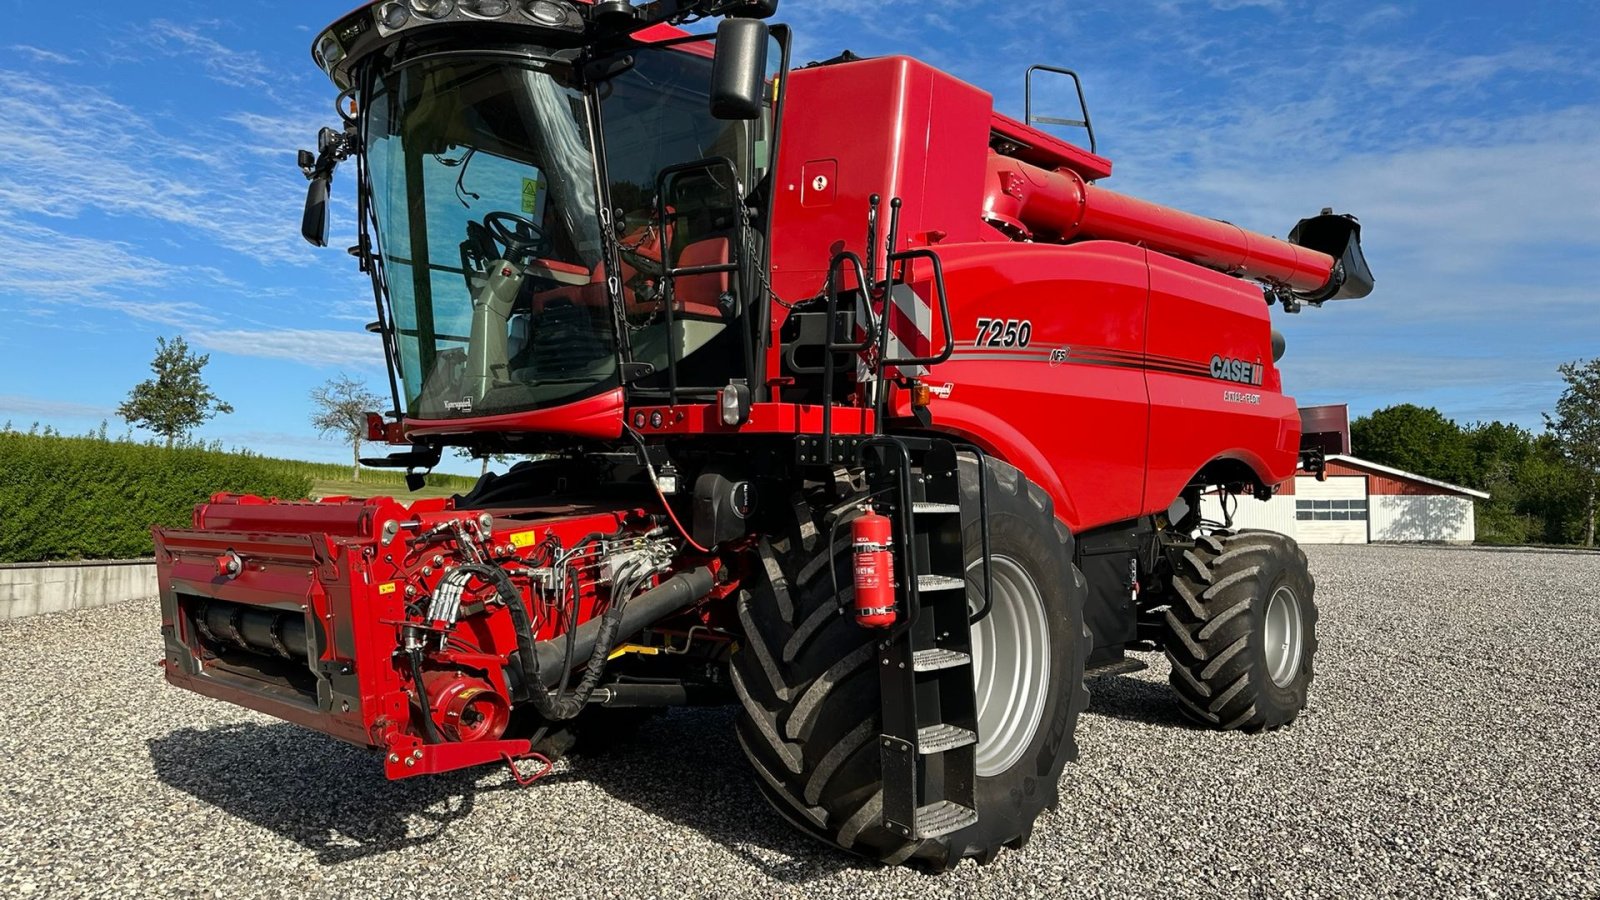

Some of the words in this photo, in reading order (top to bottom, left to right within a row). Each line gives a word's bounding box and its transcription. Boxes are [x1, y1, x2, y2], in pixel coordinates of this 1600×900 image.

[975, 317, 1032, 349] 7250
[1049, 348, 1066, 361] AFS
[1210, 355, 1251, 383] CASE
